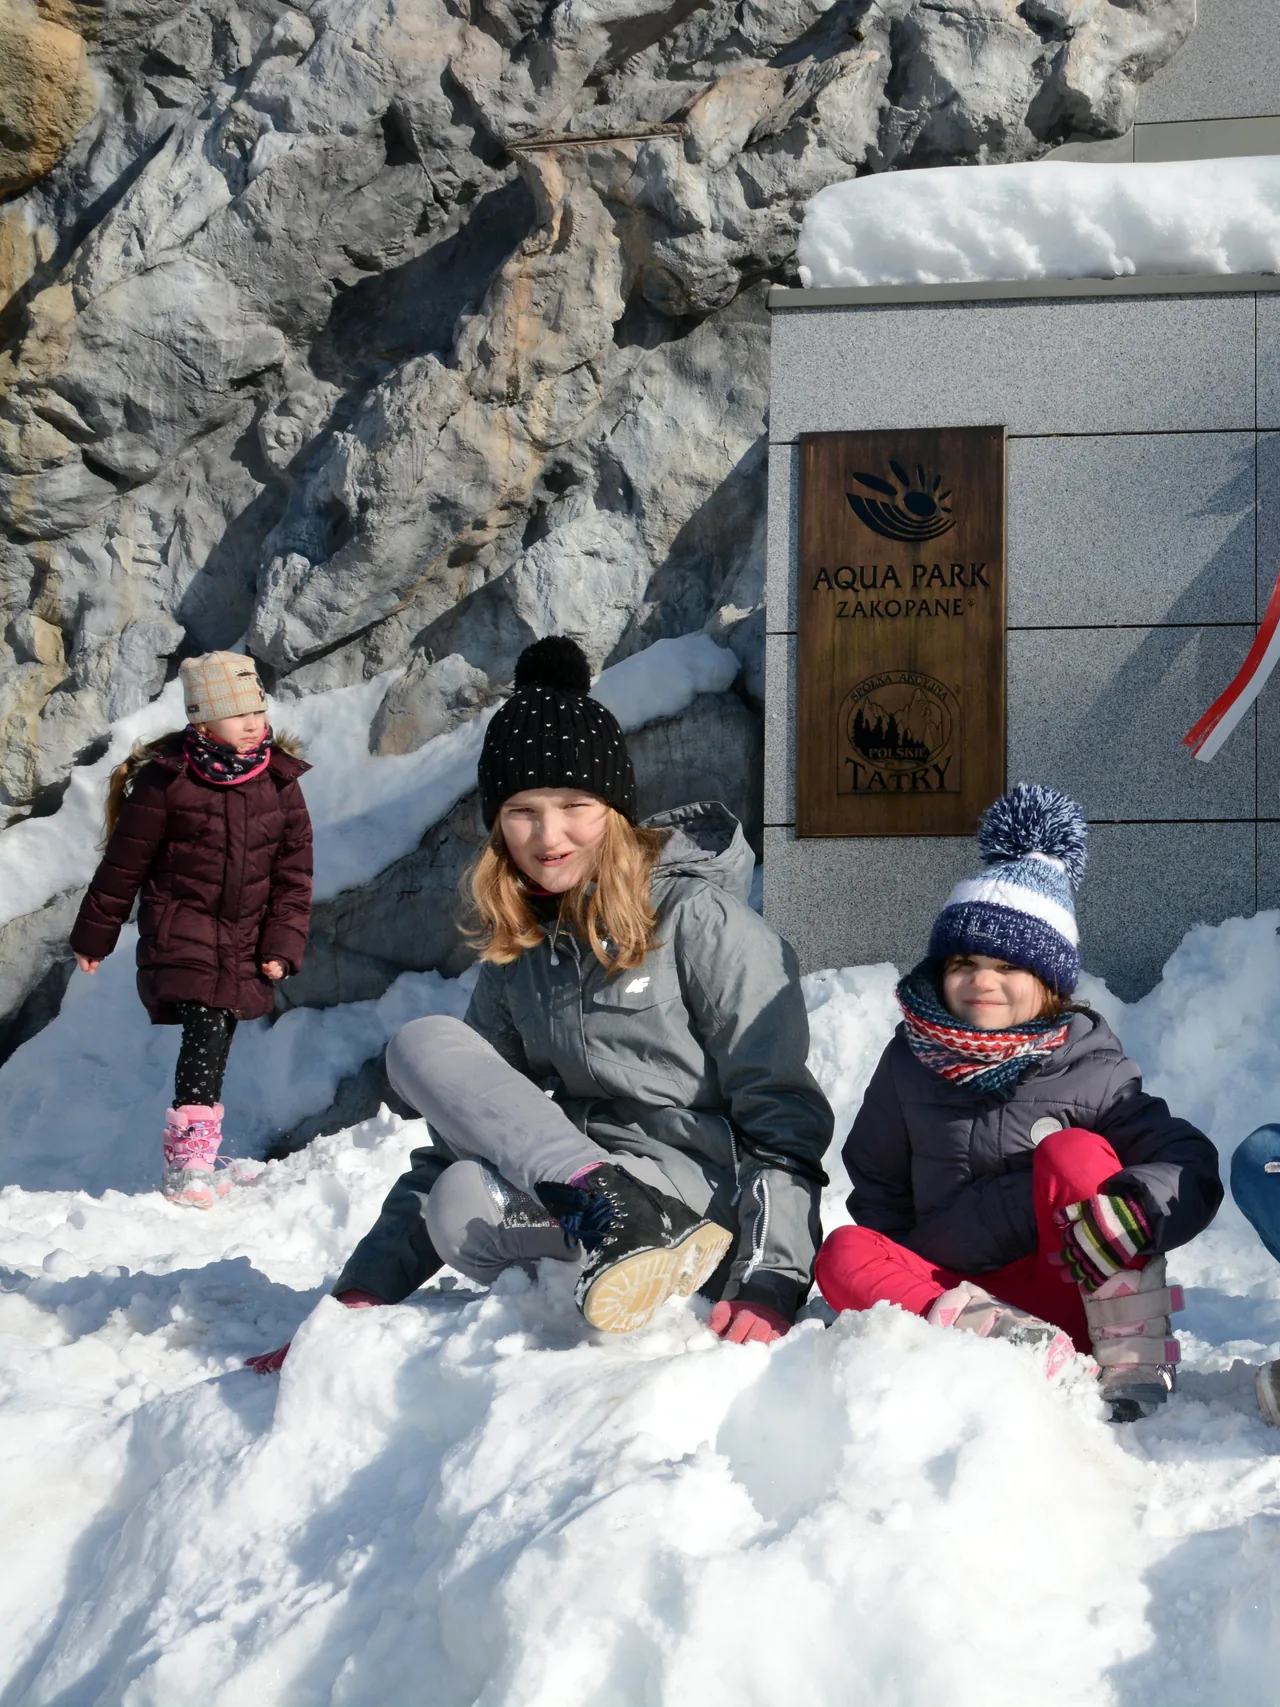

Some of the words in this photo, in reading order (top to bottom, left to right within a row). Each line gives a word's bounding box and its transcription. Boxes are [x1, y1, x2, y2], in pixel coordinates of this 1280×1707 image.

[812, 566, 901, 592] AQUA
[912, 563, 990, 588] PARK
[836, 598, 964, 619] ZAKOPANE
[899, 673, 949, 700] AKCYJNA
[868, 747, 928, 758] POLSKIE
[845, 755, 952, 790] TATRY
